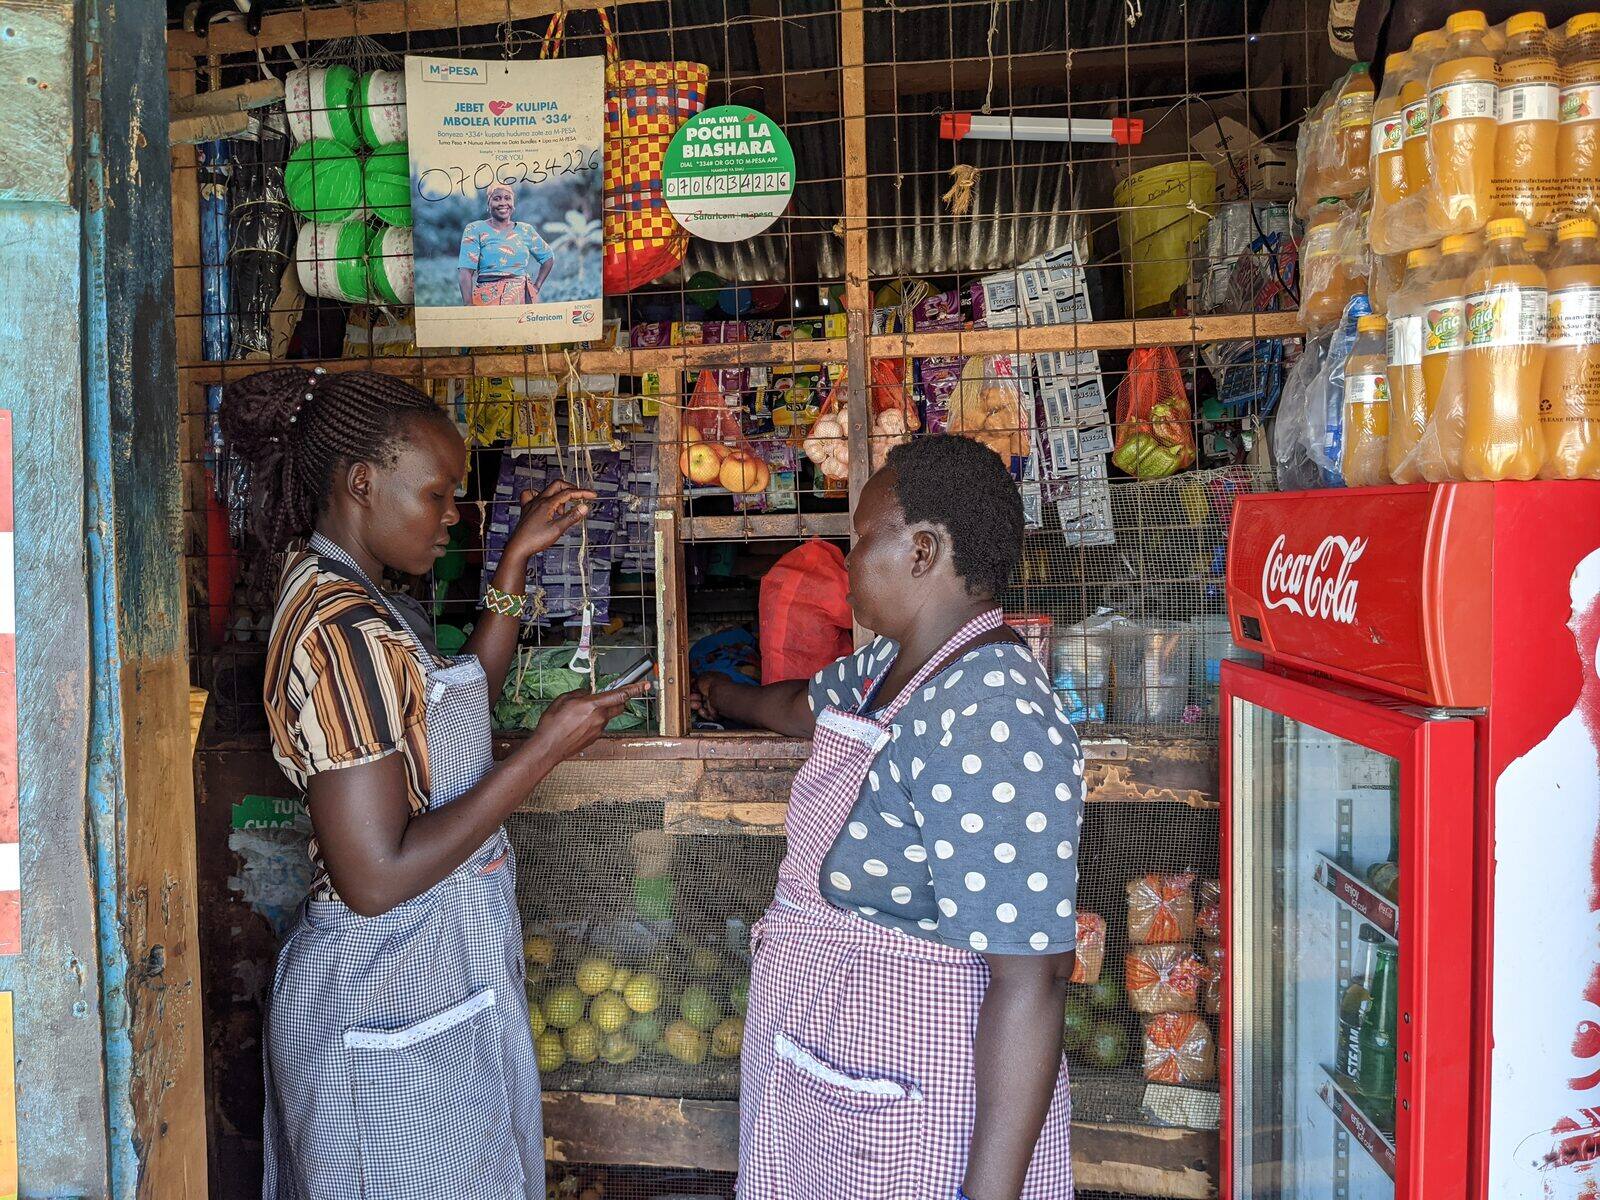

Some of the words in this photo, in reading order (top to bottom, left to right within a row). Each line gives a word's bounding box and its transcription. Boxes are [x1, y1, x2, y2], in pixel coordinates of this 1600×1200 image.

[455, 102, 484, 113] JEBET
[516, 101, 558, 112] KULIPIA
[443, 116, 490, 127] MBOLEA
[493, 116, 537, 127] KUPITIA
[698, 117, 716, 125] LIPA
[686, 125, 741, 141] POCHI
[748, 123, 771, 138] LA
[682, 139, 775, 159] BIASHARA
[526, 314, 563, 322] Safaricom
[1261, 533, 1369, 625] Coca-Cola
